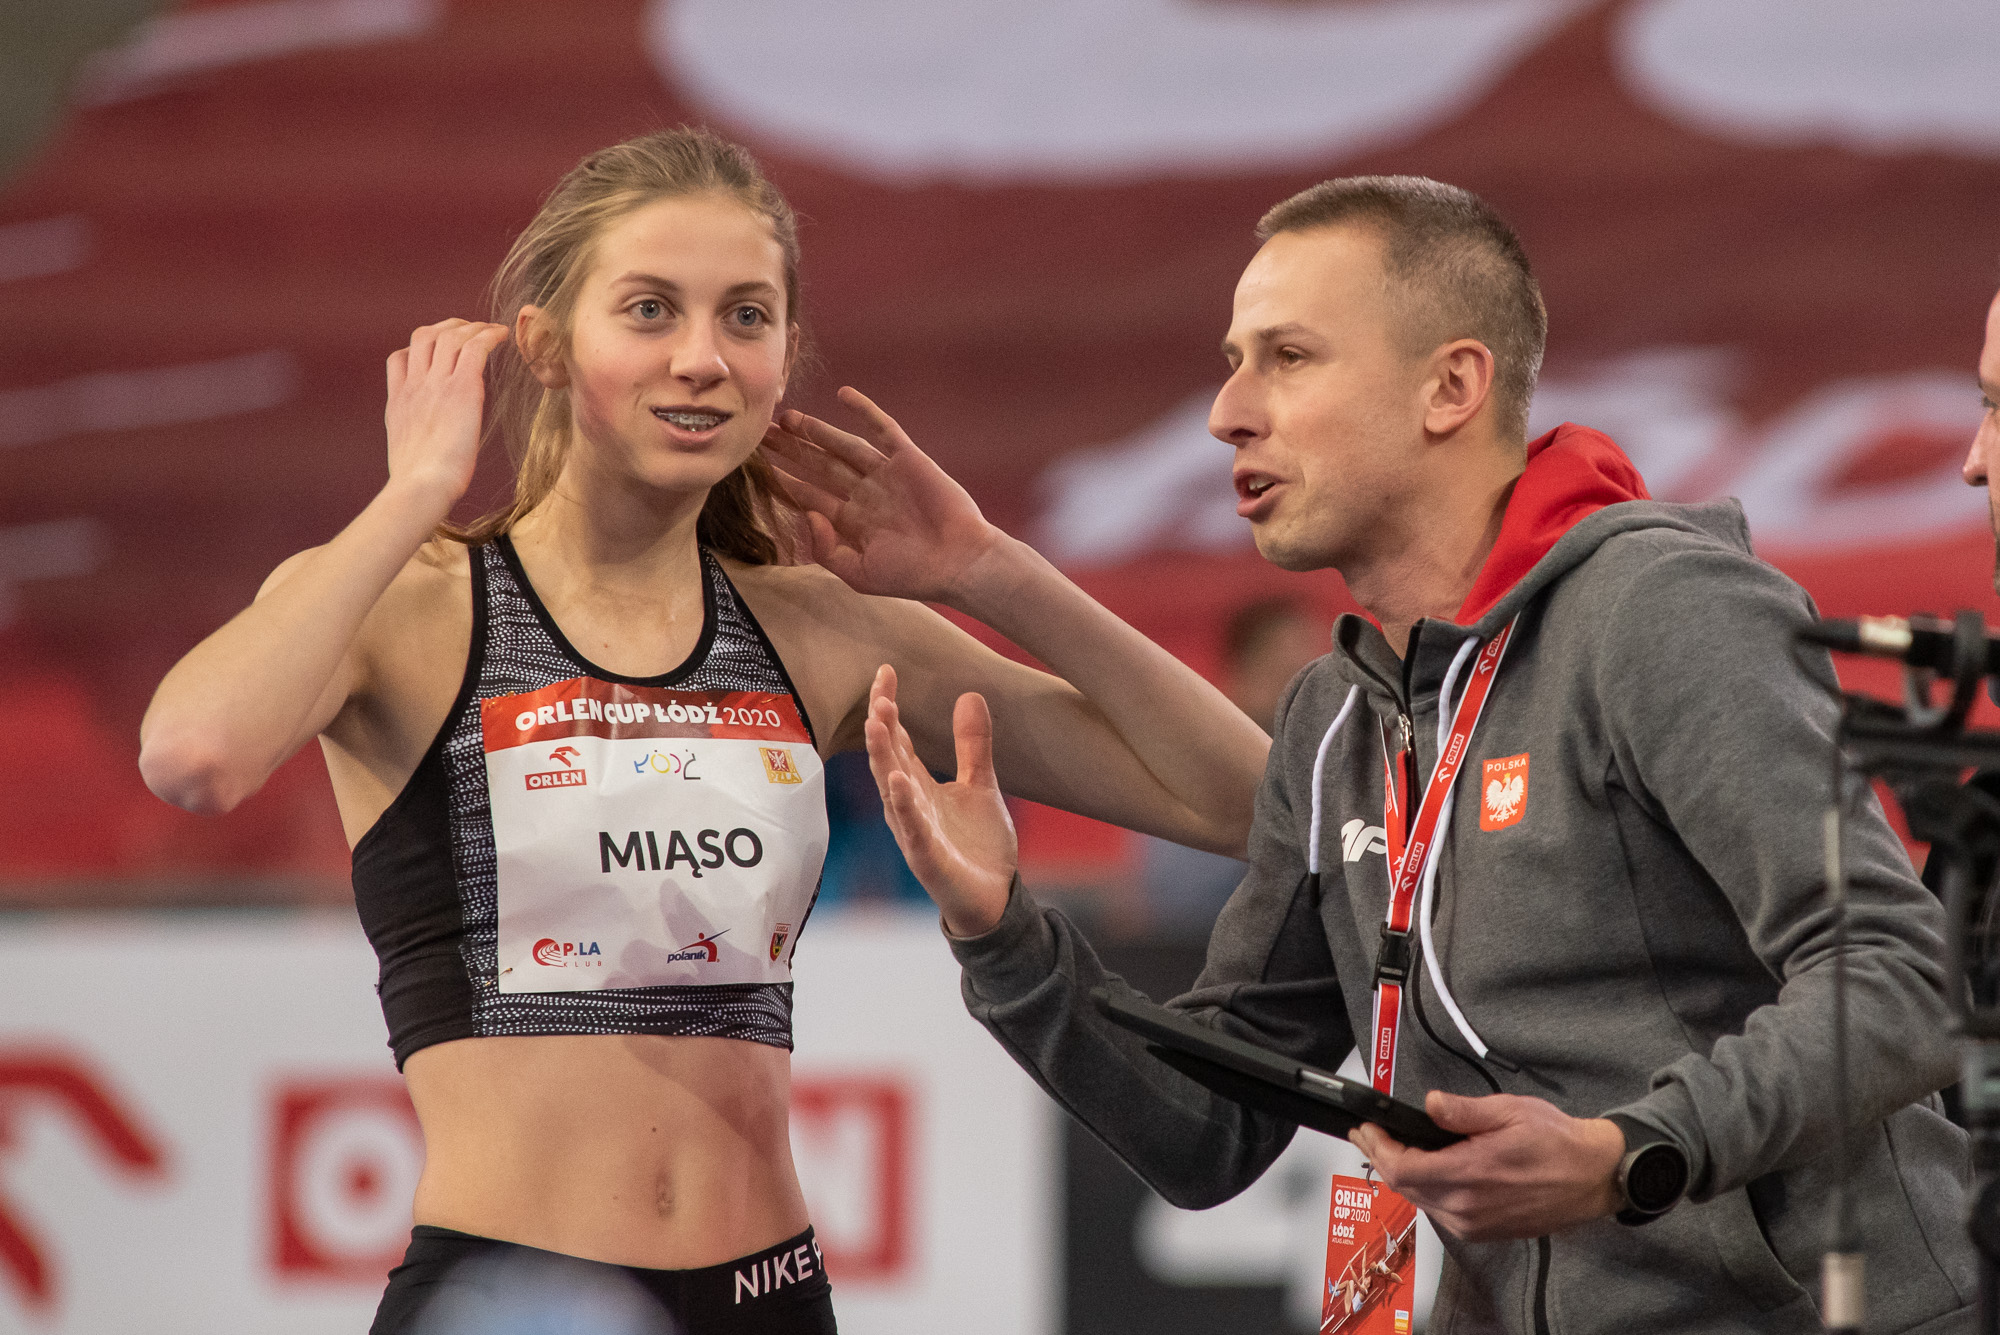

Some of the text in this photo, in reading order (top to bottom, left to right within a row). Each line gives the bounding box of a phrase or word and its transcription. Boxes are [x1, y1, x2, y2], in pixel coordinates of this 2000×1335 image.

[515, 698, 603, 731] ORLEN
[604, 703, 651, 724] CUP
[723, 707, 781, 728] 2020
[1447, 735, 1463, 763] ORLEN
[1486, 758, 1527, 773] POLSKA
[528, 772, 583, 788] ORLEN
[598, 827, 763, 878] MIĄSO
[1409, 843, 1423, 872] ORLEN
[563, 942, 601, 956] P.LA
[667, 950, 707, 963] polanik
[1381, 1028, 1391, 1058] ORLEN
[1335, 1189, 1372, 1209] ORLEN
[1334, 1206, 1371, 1223] CUP 2020
[1332, 1222, 1355, 1238] ŁÓDŹ
[735, 1244, 813, 1304] NIKE
